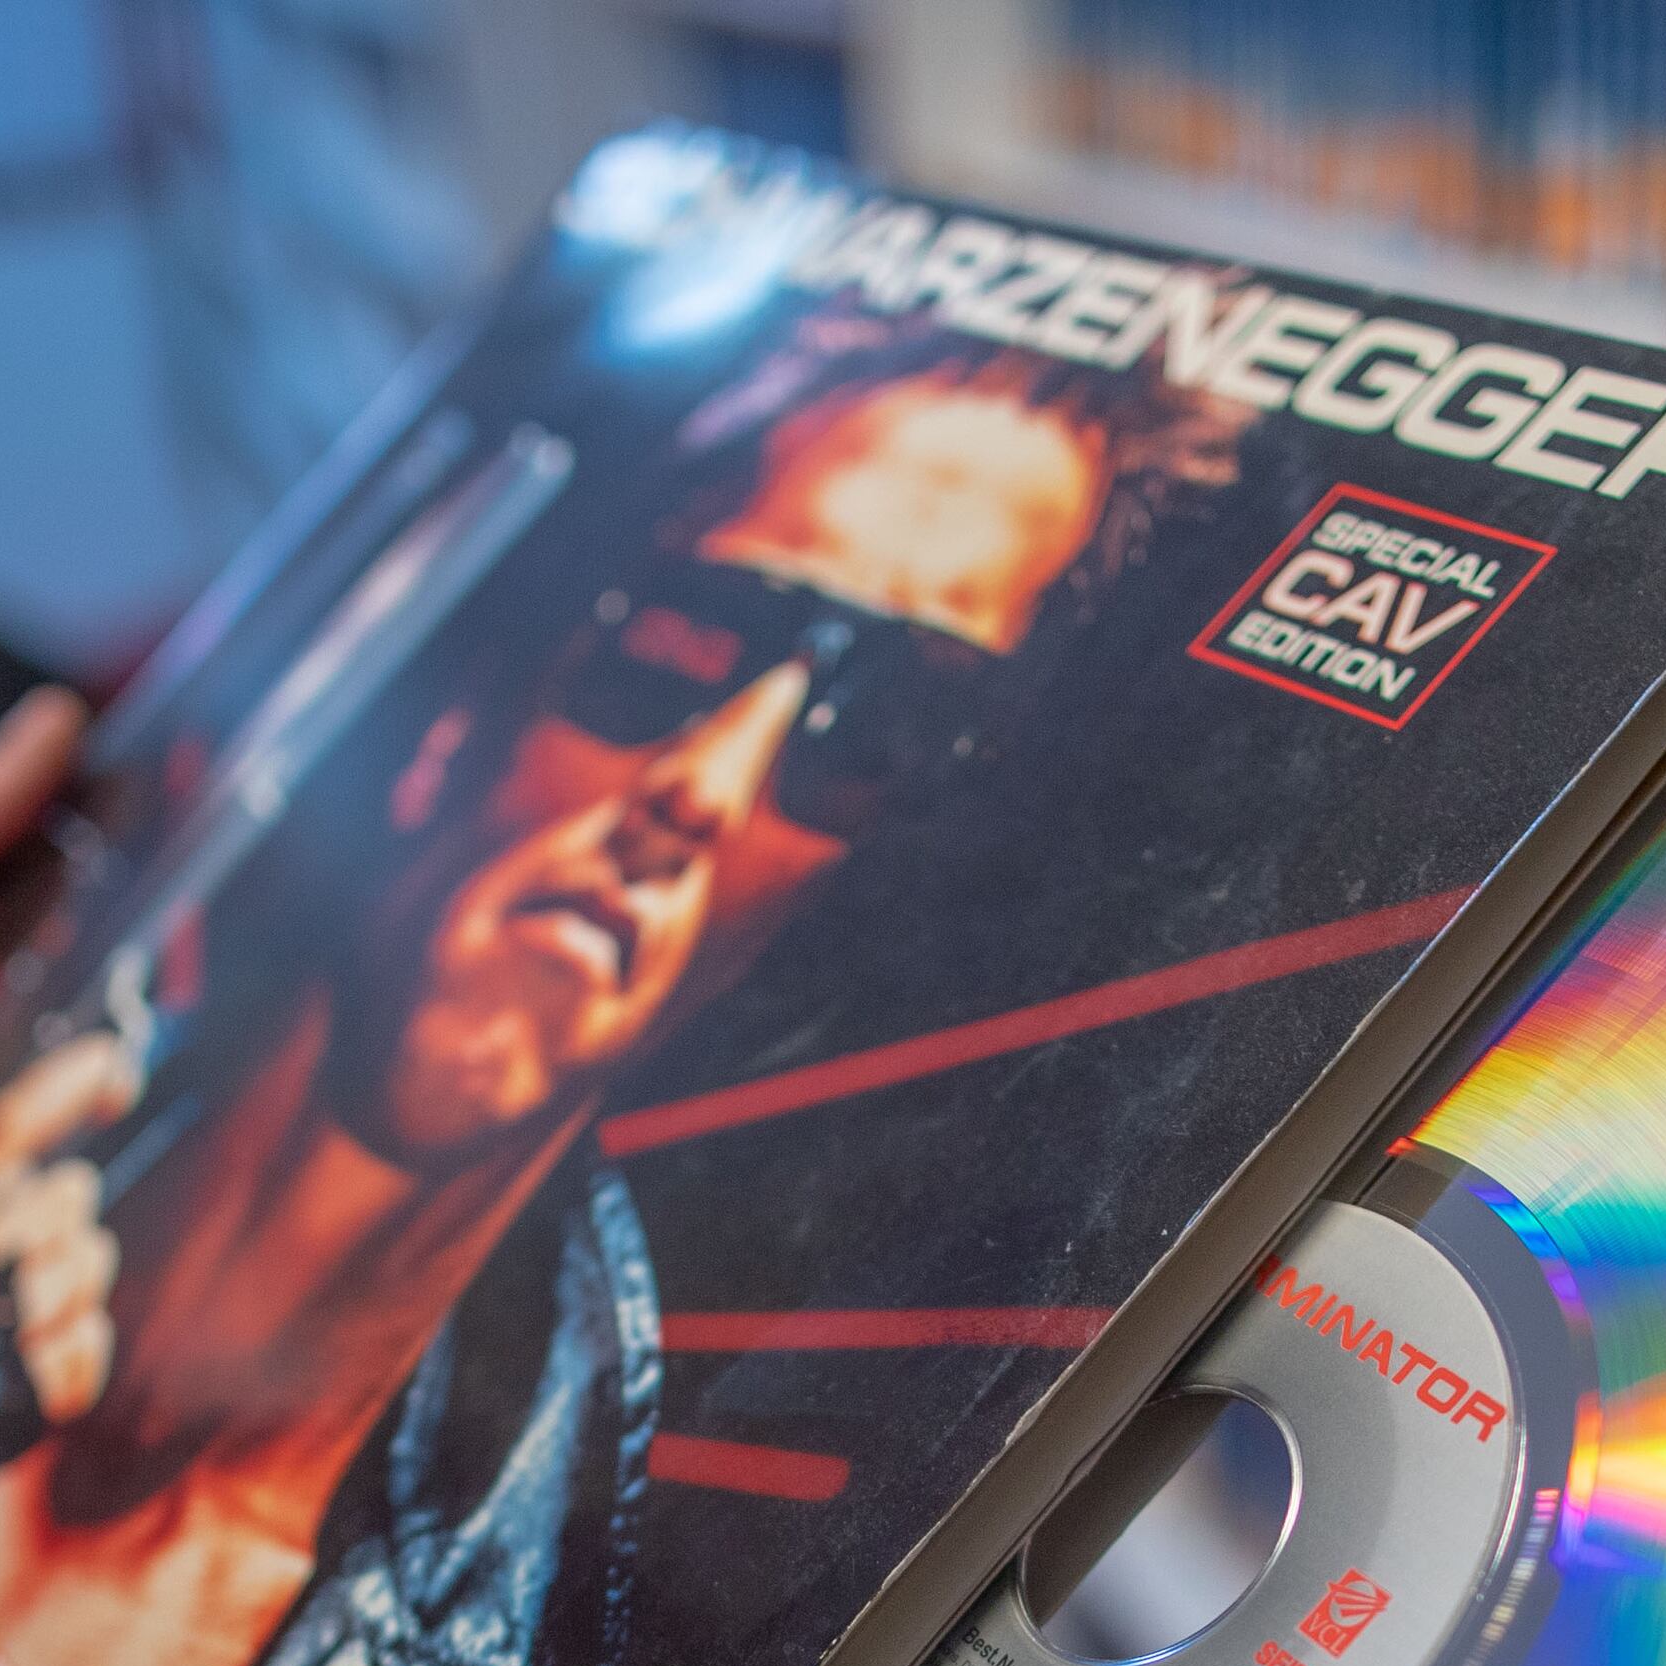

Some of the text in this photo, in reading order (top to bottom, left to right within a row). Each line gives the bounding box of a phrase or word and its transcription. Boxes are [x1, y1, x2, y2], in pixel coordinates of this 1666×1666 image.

[1311, 511, 1500, 599] SPECIAL
[1262, 549, 1480, 654] CAV
[1227, 610, 1416, 702] EDITION
[1307, 1612, 1350, 1655] VCL
